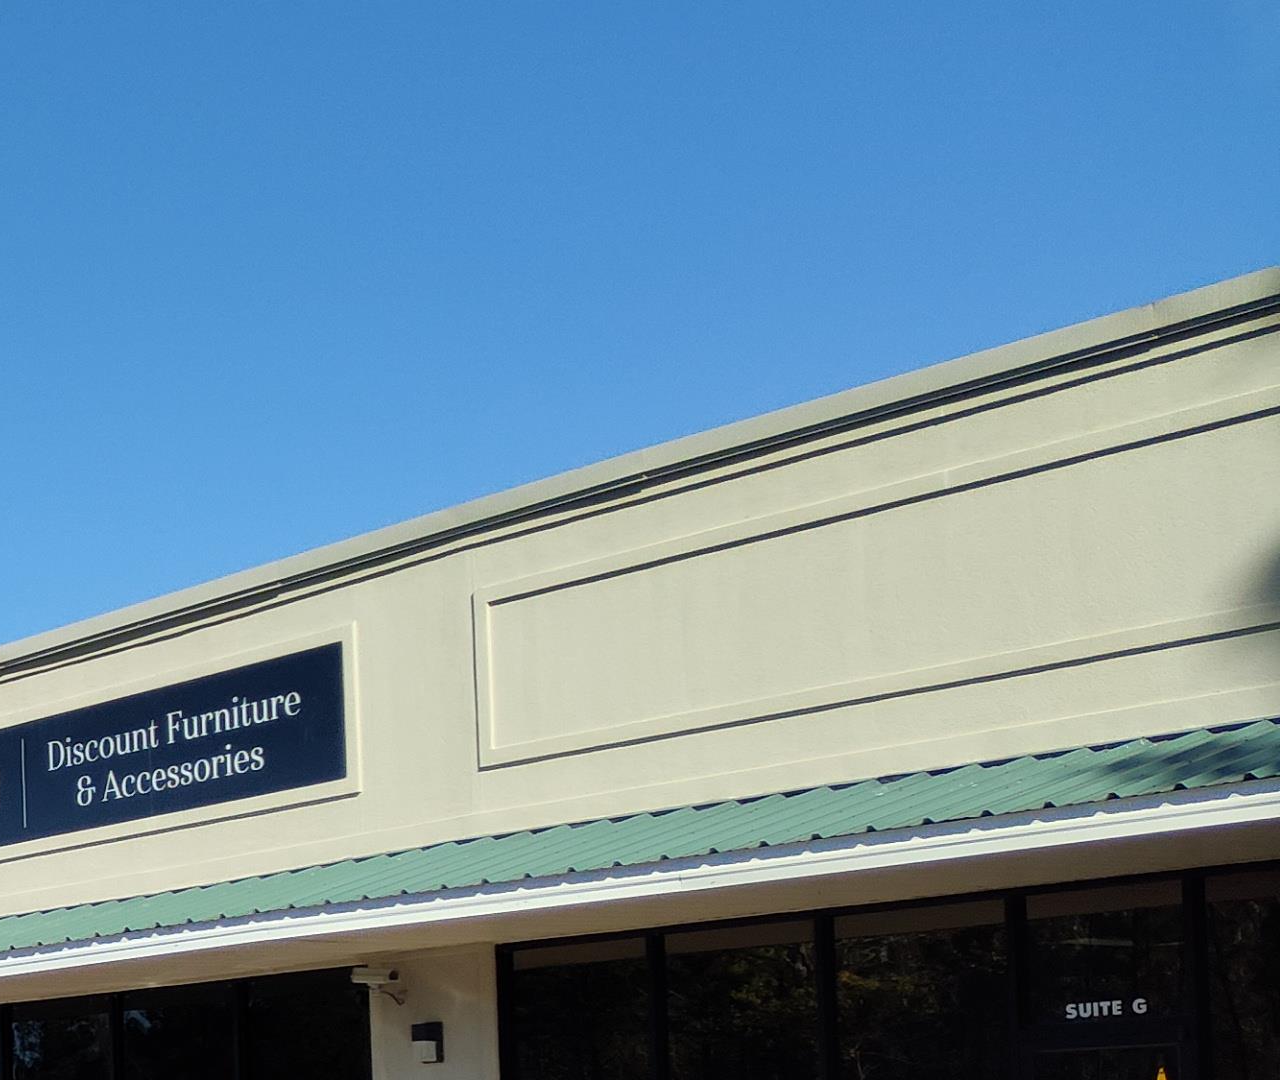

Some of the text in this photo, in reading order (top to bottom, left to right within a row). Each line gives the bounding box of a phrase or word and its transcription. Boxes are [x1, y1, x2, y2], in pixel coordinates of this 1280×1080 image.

[47, 689, 302, 773] Discount Furniture
[76, 745, 266, 807] & Accessories
[1065, 998, 1147, 1019] SUITE G
